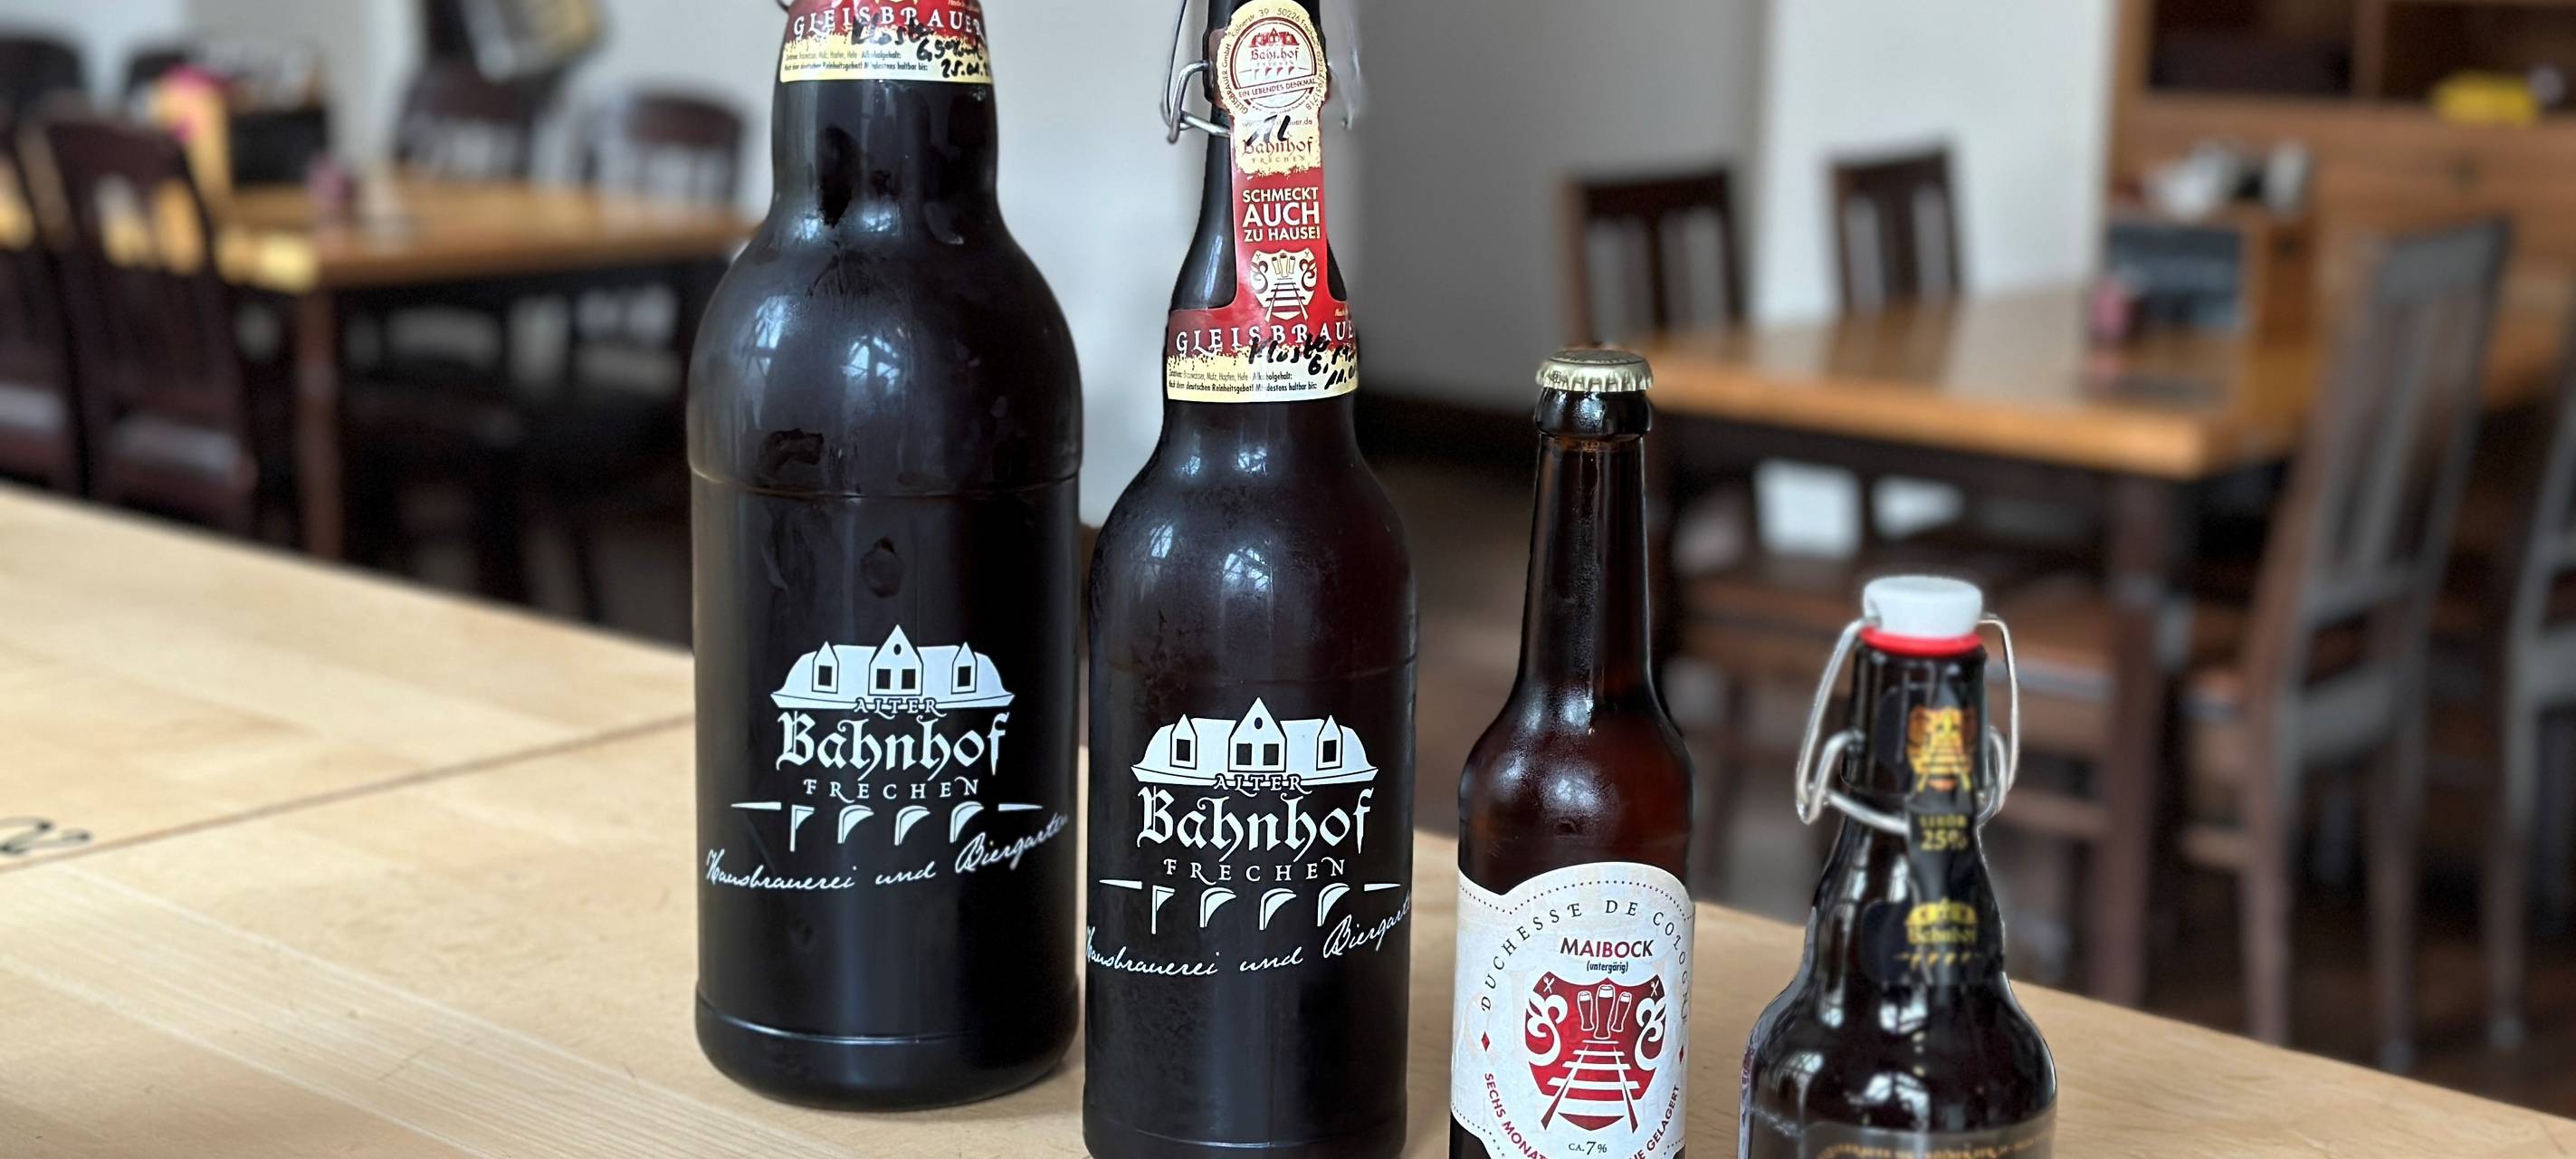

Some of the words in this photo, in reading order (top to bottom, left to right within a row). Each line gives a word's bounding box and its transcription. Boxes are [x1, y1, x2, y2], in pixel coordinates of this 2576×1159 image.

[1238, 89, 1250, 98] EIN
[1252, 83, 1284, 96] LEBENDES
[1285, 77, 1317, 90] DENKMAL
[1242, 187, 1319, 203] SCHMECKT
[1242, 201, 1321, 228] AUCH
[1244, 228, 1264, 242] ZU
[1268, 226, 1321, 242] HAUSE!
[1289, 382, 1307, 390] haltbar
[854, 697, 948, 720] ALTER
[776, 711, 1010, 781] Bahnhof
[804, 776, 978, 804] FRECHEN
[1213, 773, 1312, 798] ALTER
[1137, 785, 1375, 863] Bahnhof
[705, 848, 857, 892] Hausbrauerei
[875, 861, 936, 886] und
[1163, 857, 1345, 886] FRECHEN
[1239, 946, 1303, 972] und
[1481, 902, 1582, 1012] DUCHESSE
[1605, 899, 1638, 916] DE
[1560, 937, 1655, 959] MAIBOCK
[1586, 960, 1629, 975] (untergärig)
[1484, 1072, 1506, 1118] SECHS
[1646, 1084, 1680, 1152] GELAGERT
